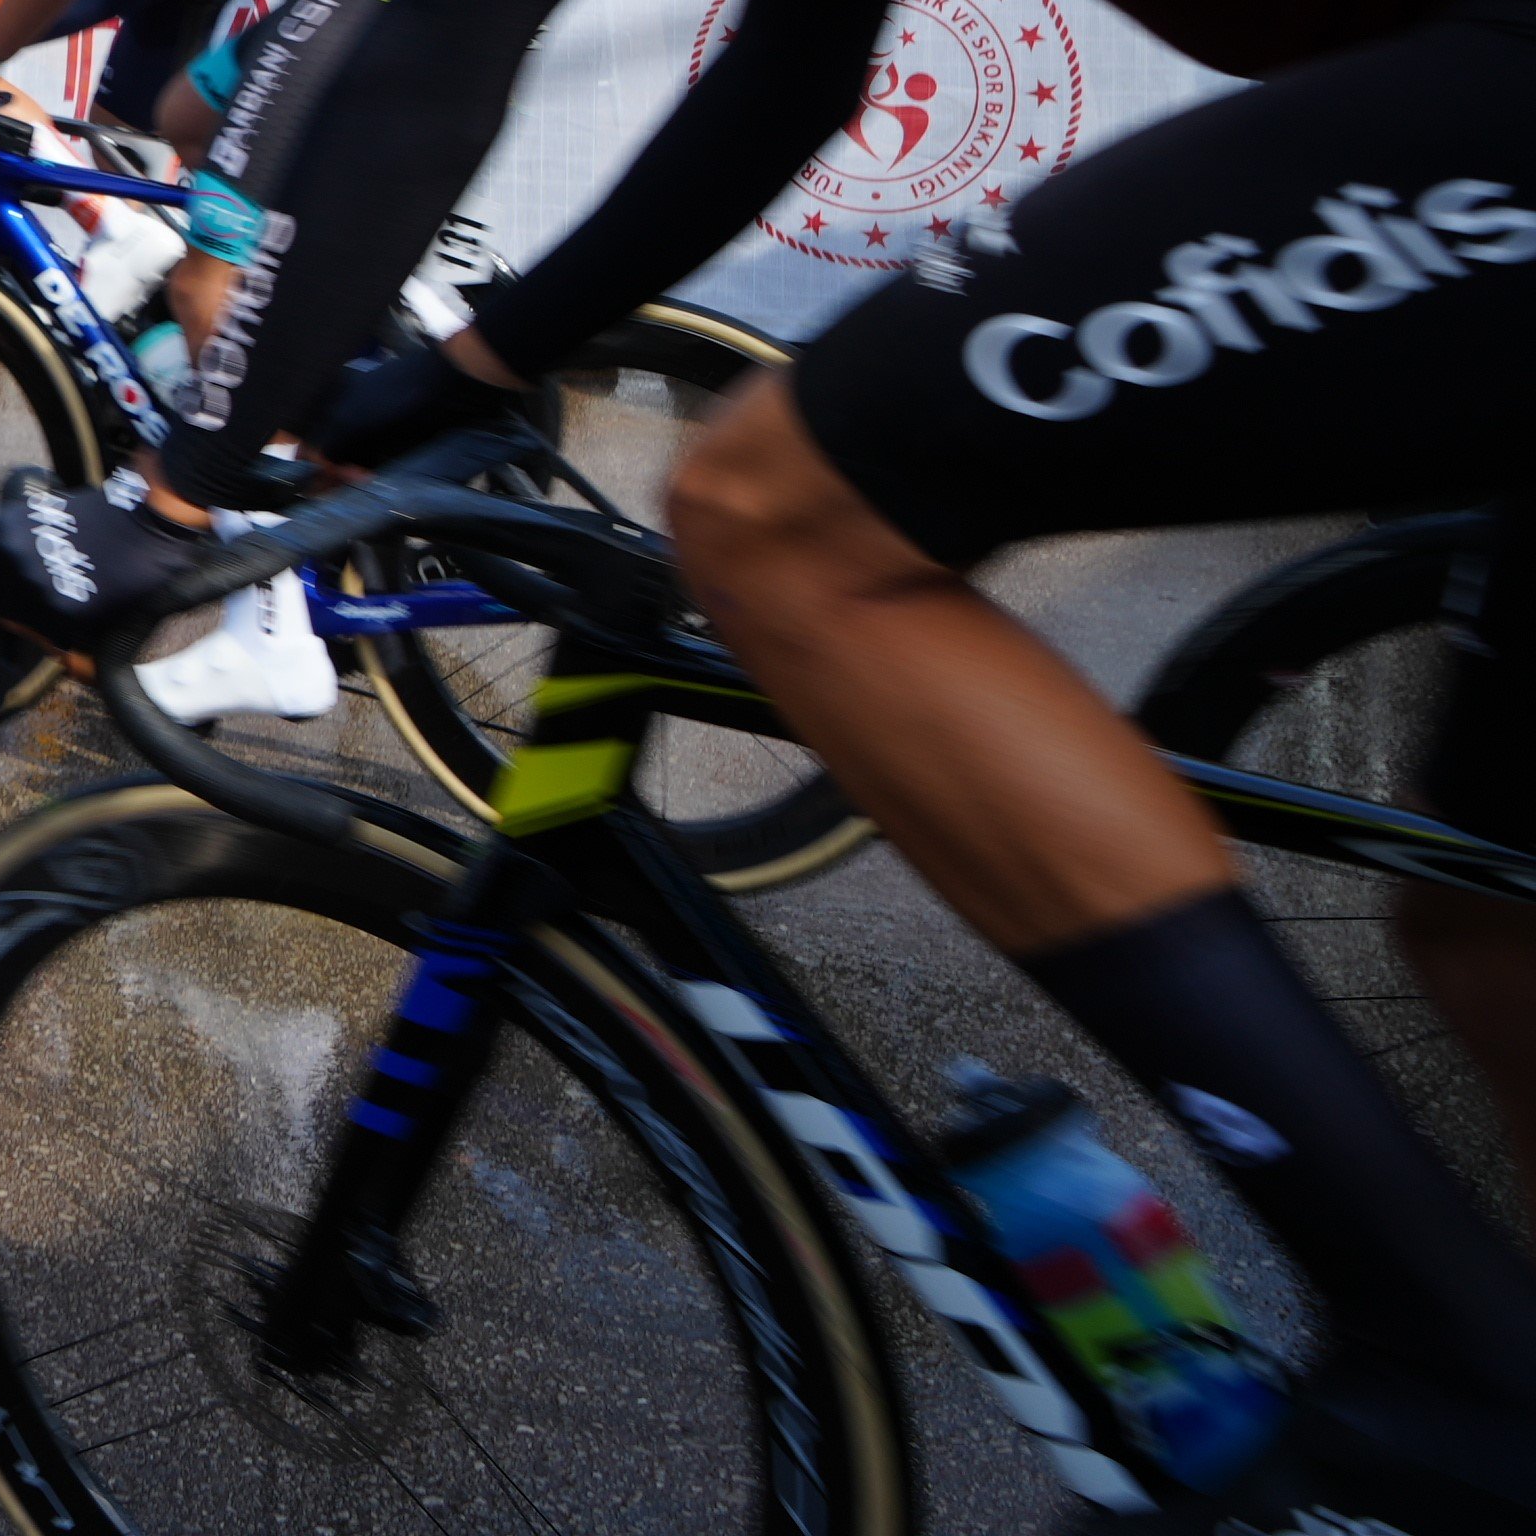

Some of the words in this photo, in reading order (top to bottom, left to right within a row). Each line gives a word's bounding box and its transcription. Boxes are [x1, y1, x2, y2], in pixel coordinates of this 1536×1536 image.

[951, 6, 979, 36] VE
[971, 35, 1004, 94] SPOR
[910, 101, 1003, 200] BAKANLIĞI
[962, 177, 1536, 421] Cofidis
